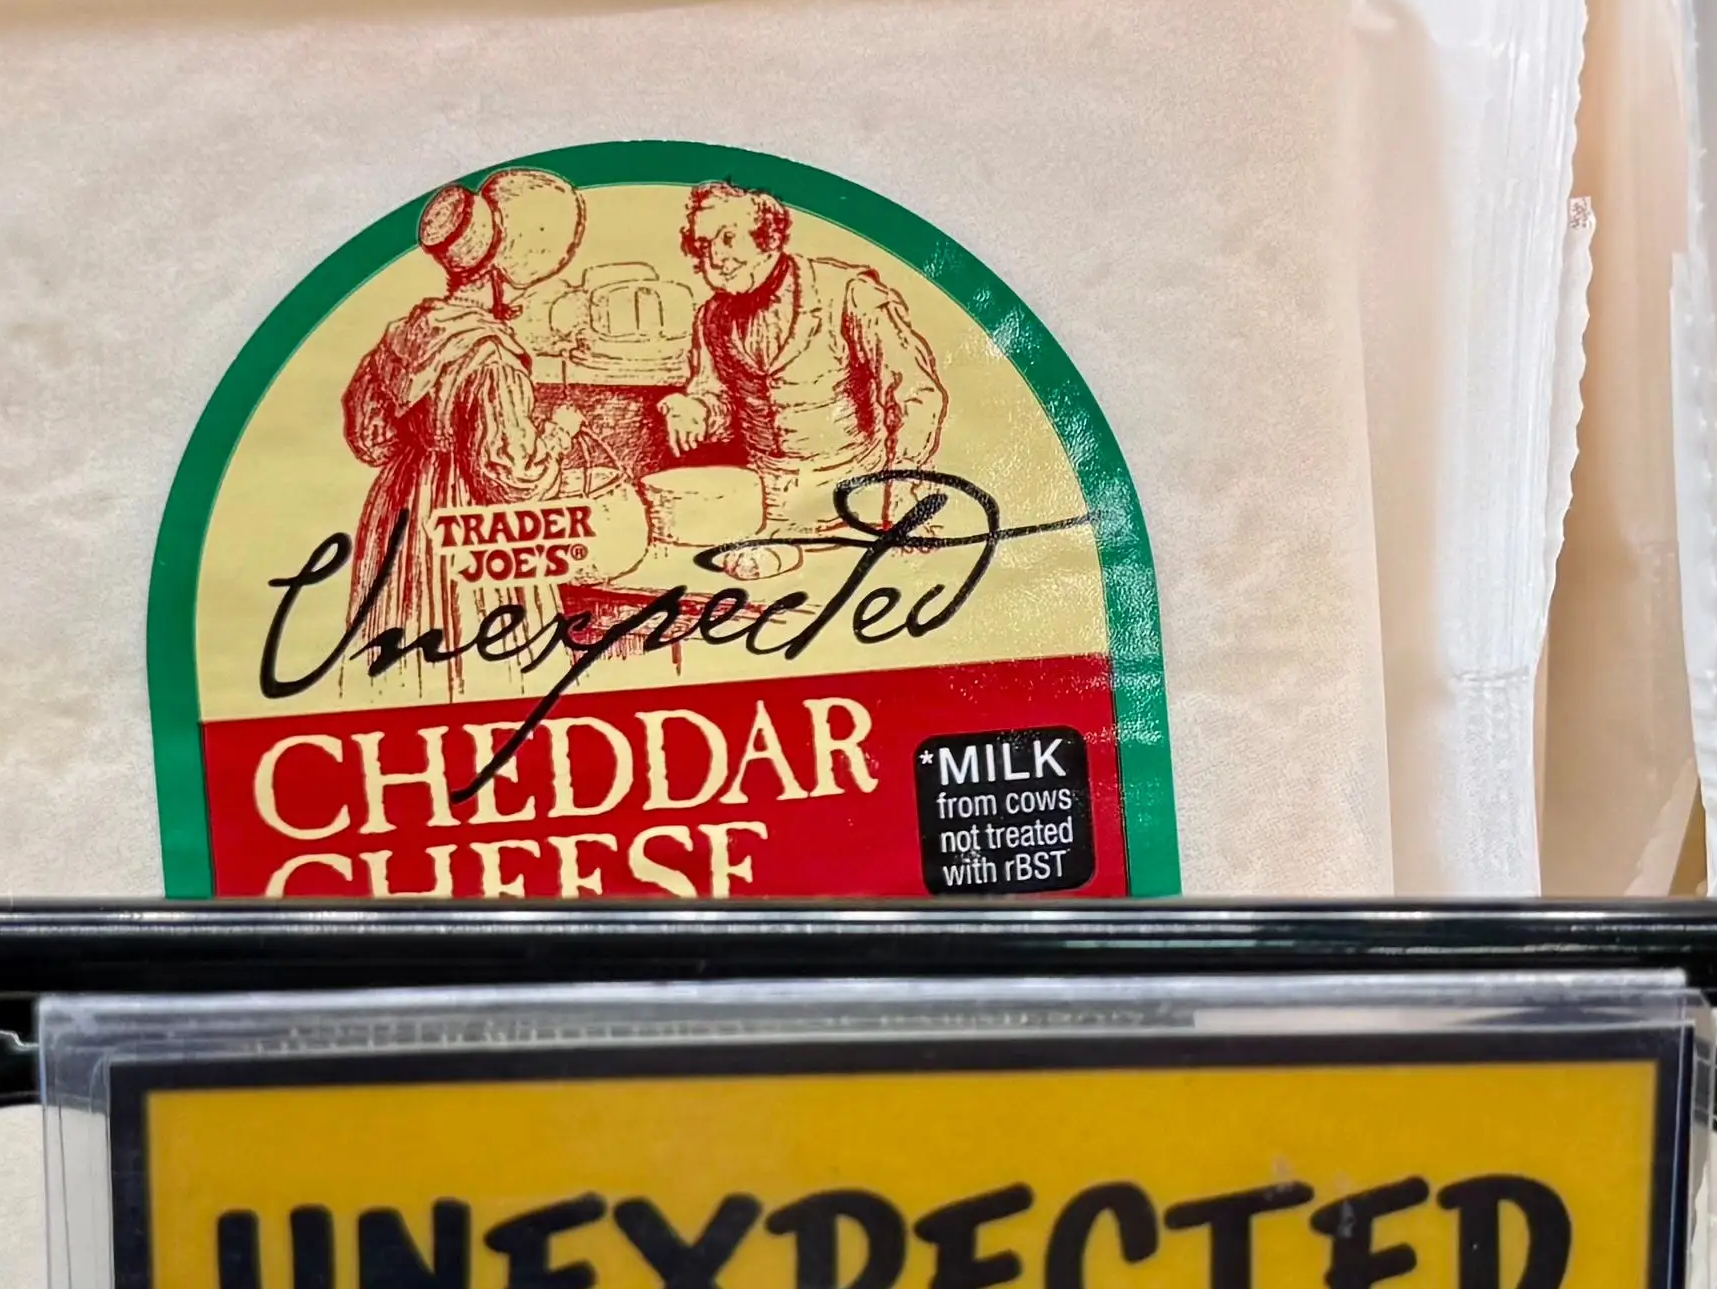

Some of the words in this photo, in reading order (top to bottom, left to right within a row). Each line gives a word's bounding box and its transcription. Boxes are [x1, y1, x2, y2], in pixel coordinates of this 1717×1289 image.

[433, 505, 597, 548] TRADER
[258, 467, 1102, 804] Unexpected
[253, 696, 881, 842] CHEDDAR
[936, 791, 998, 820] from
[1005, 788, 1073, 815] cows
[939, 824, 982, 854] not
[985, 815, 1075, 850] treated
[942, 855, 998, 888] with
[1004, 849, 1068, 883] rBST
